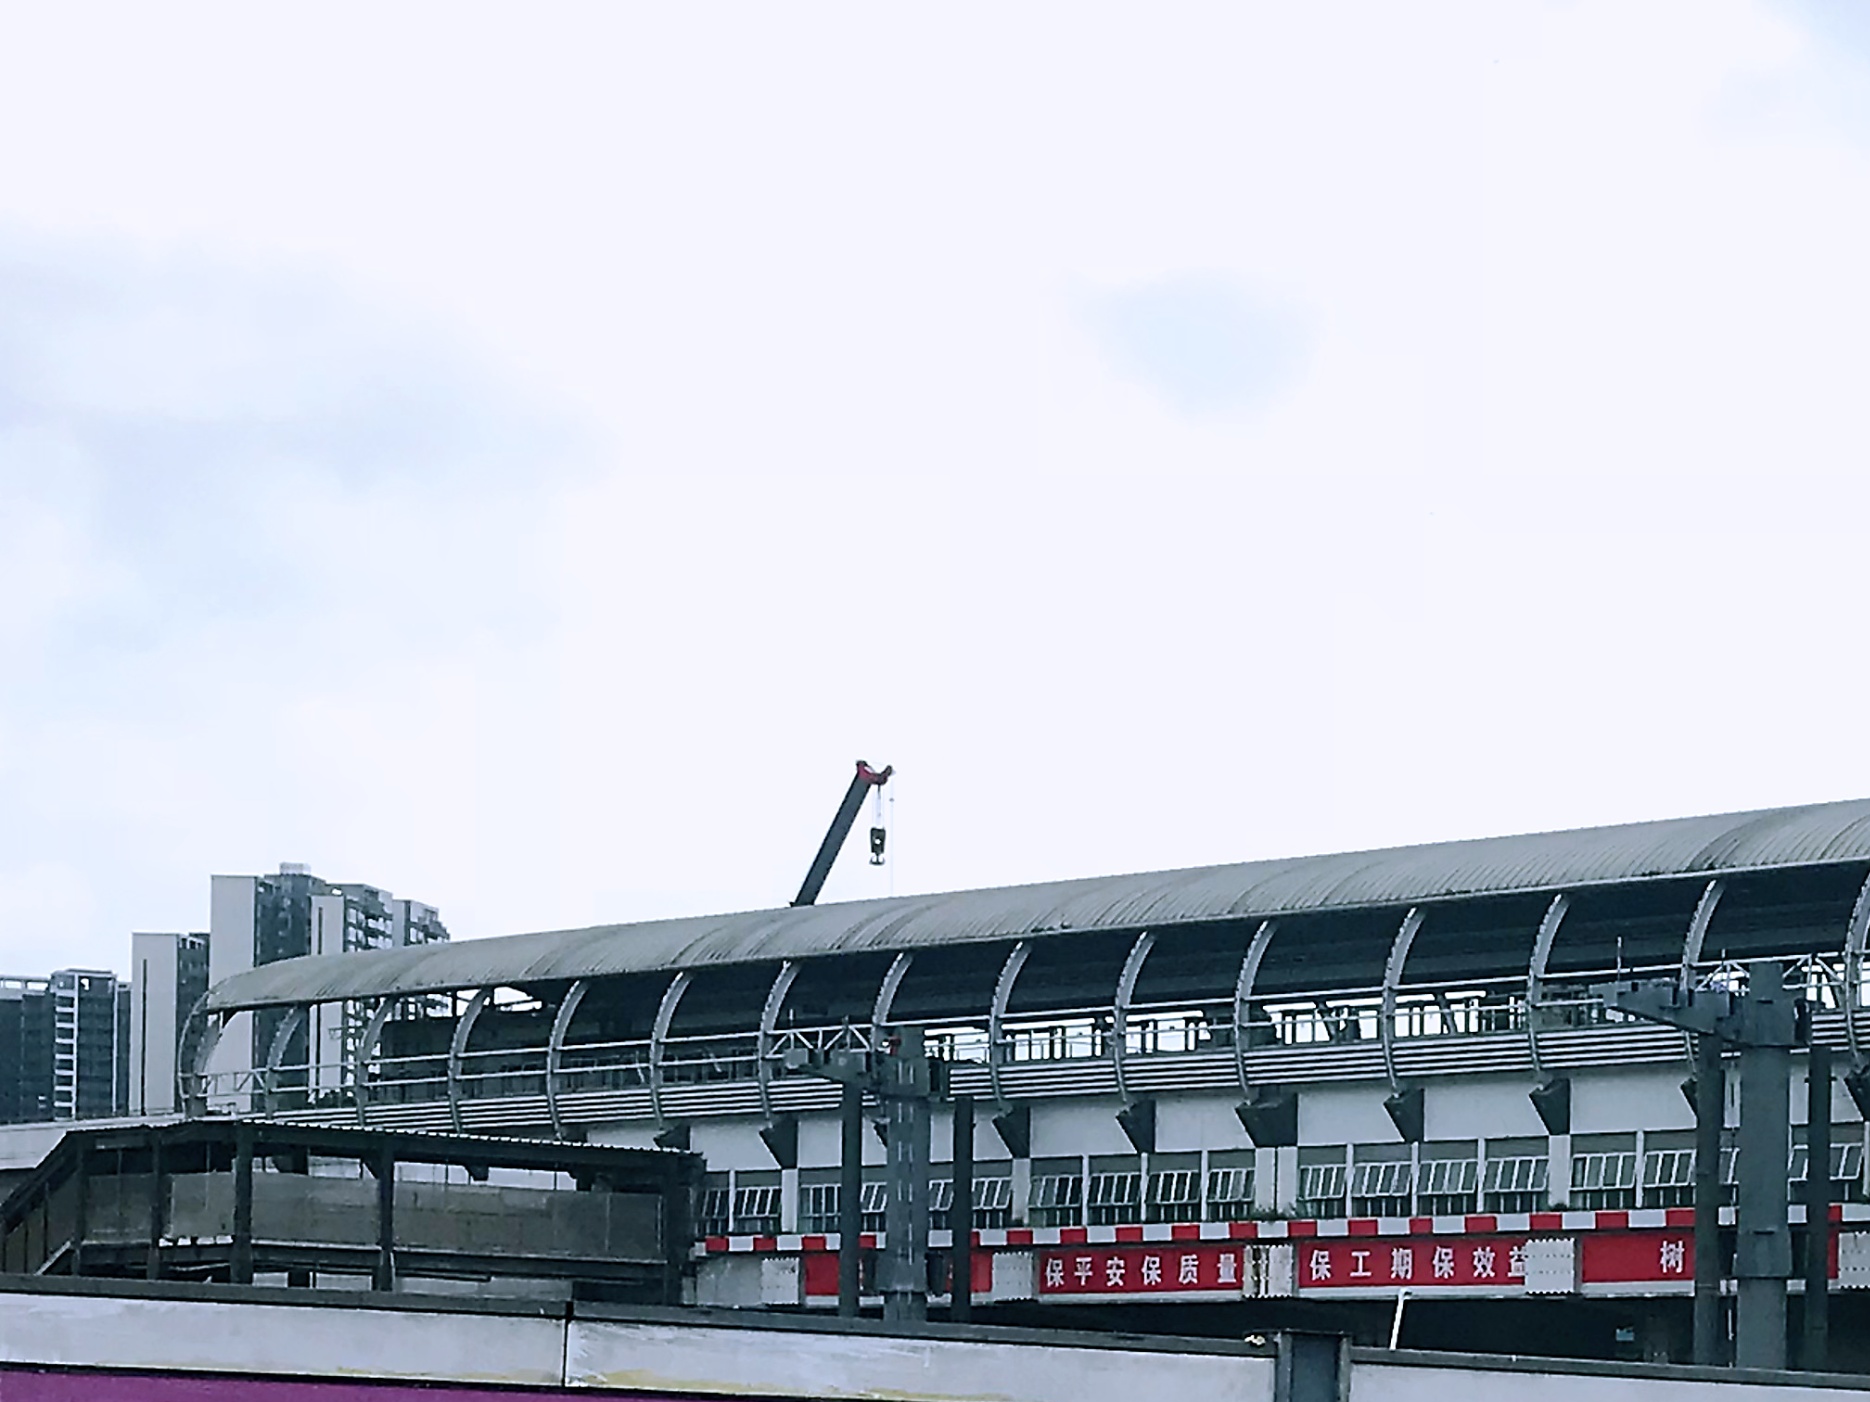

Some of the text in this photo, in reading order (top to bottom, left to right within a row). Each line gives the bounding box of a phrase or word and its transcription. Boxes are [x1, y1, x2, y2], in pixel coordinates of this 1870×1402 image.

[1045, 1253, 1237, 1287] 保平安保质量
